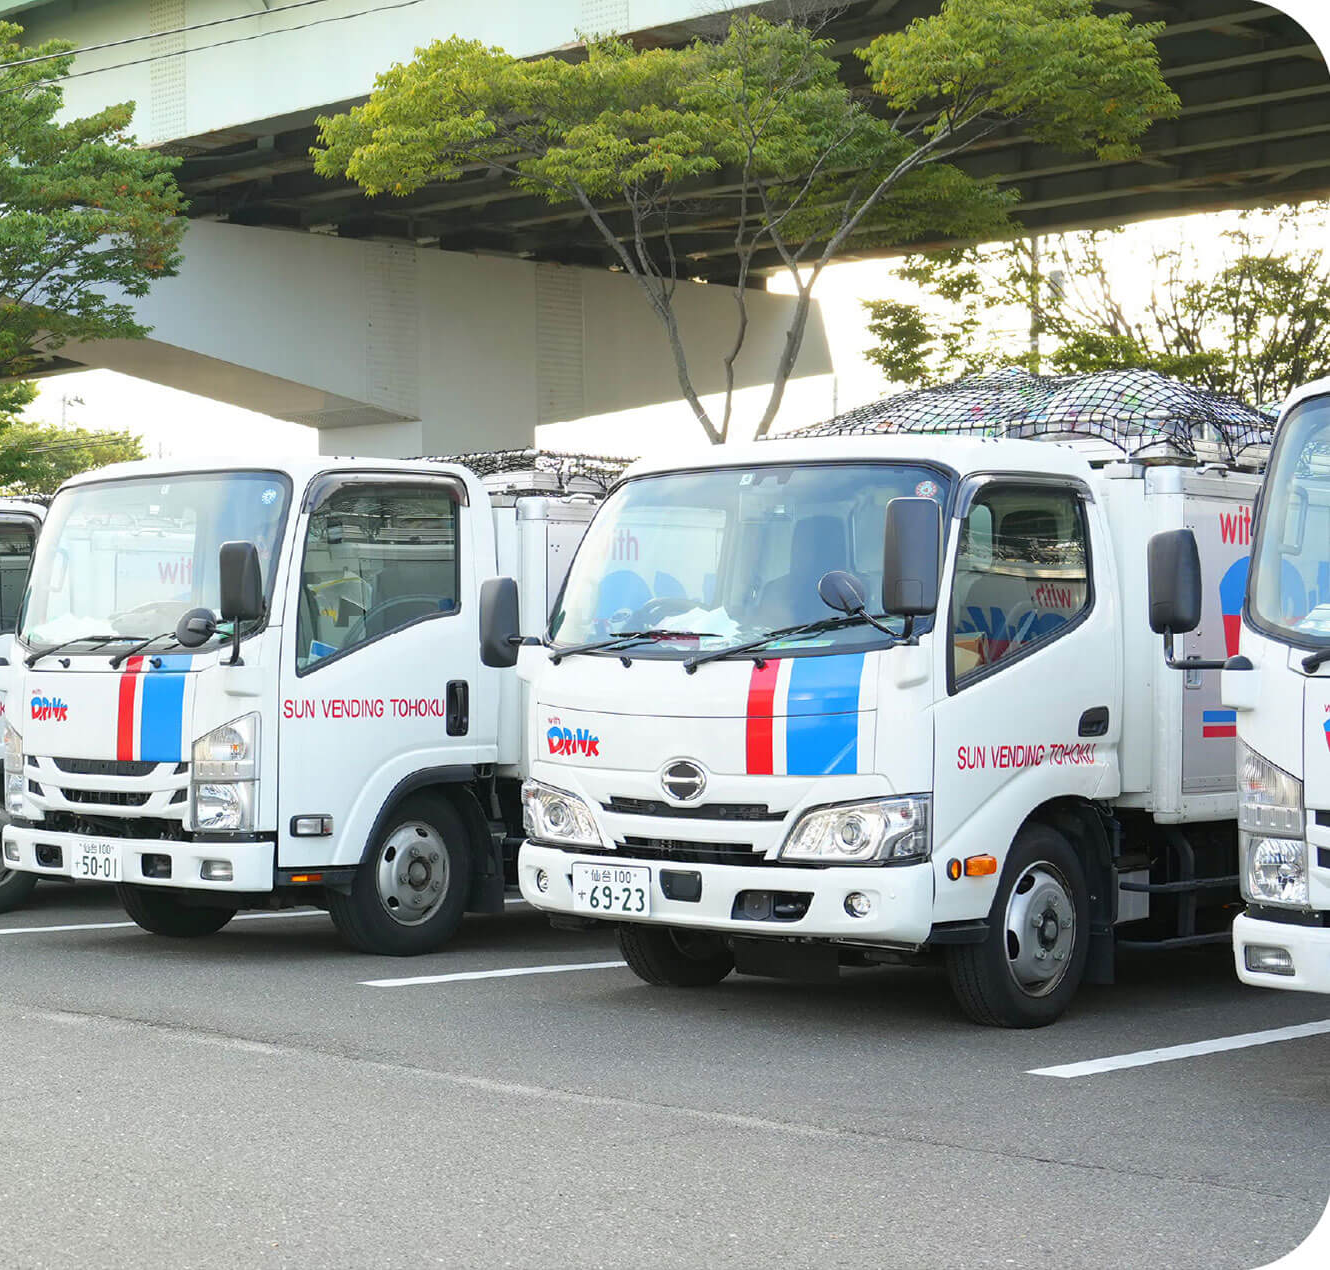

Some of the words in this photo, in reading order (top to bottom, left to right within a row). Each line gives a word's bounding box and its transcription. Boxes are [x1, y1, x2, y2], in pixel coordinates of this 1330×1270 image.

[1220, 505, 1251, 546] wit
[283, 699, 315, 718] SUN
[322, 699, 384, 718] VENDING
[390, 699, 445, 717] TOHOKU
[957, 745, 986, 770] SUN
[991, 744, 1045, 768] VENDING
[1050, 743, 1097, 765] TOHOKU
[82, 855, 117, 878] 50-01
[589, 885, 645, 912] 69-23
